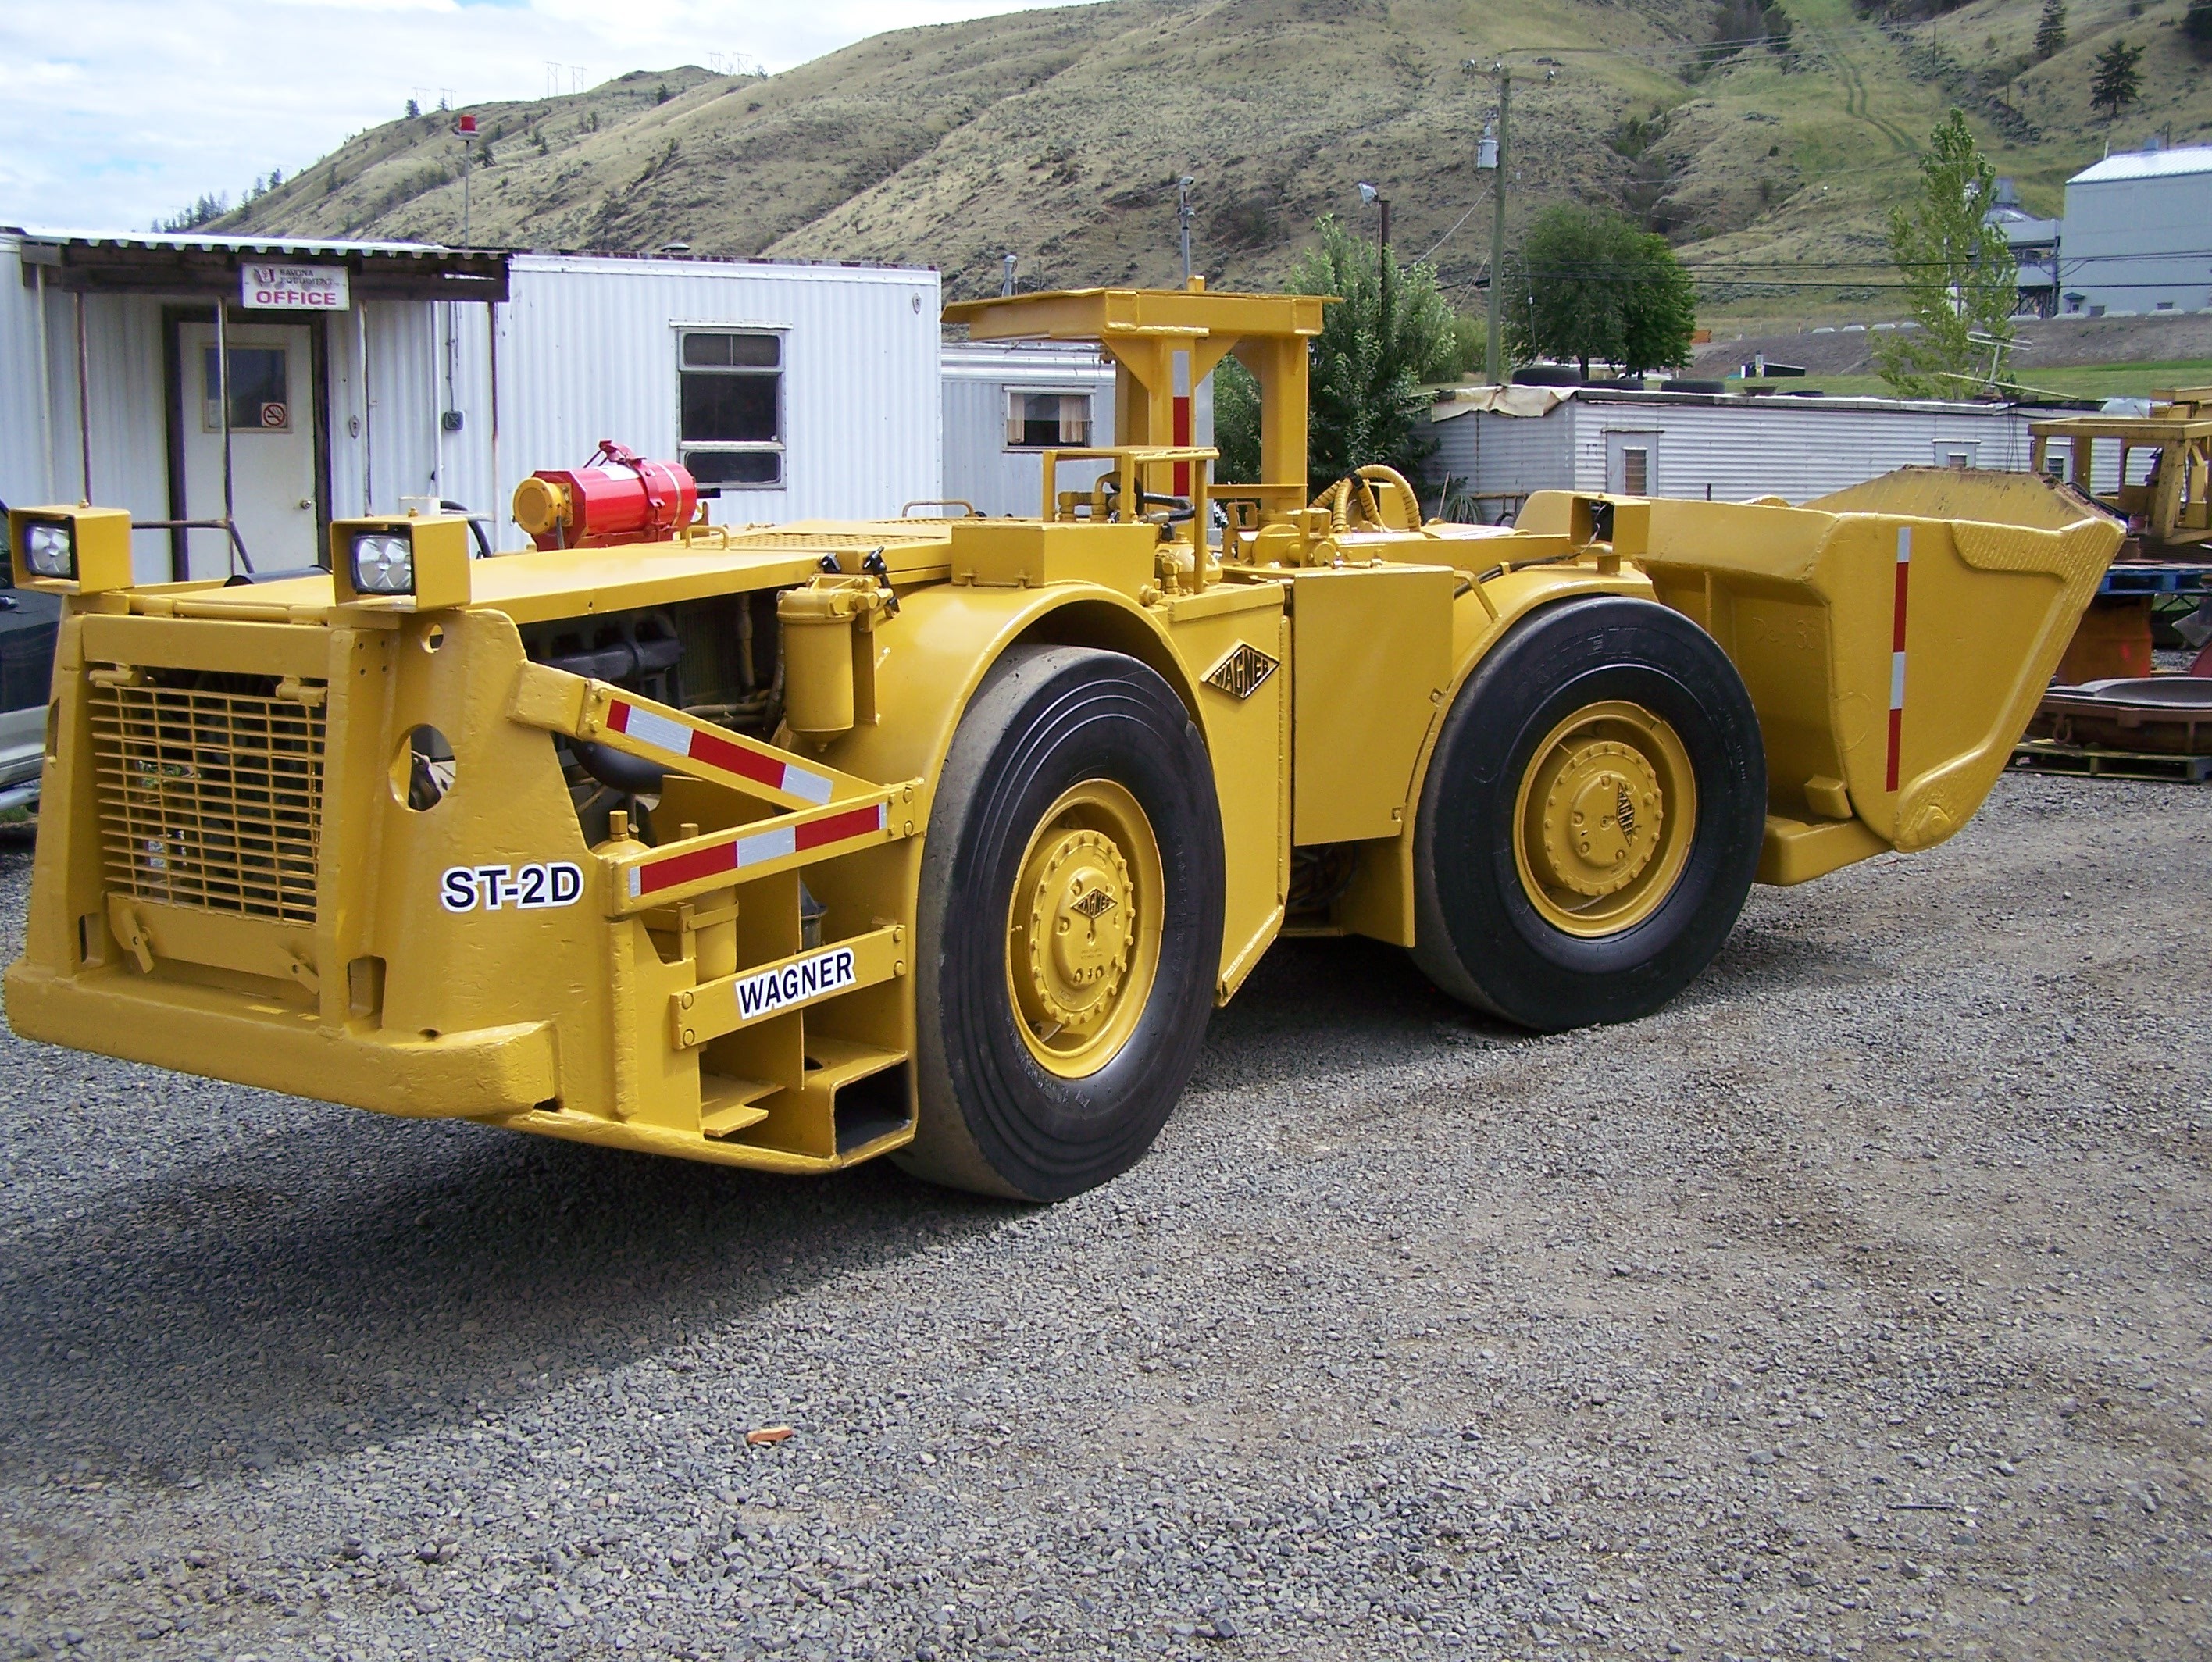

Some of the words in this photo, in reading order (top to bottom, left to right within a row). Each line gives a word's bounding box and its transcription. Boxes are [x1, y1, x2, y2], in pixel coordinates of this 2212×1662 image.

[280, 268, 314, 276] SAVONA
[280, 277, 333, 286] EQUIPMENT
[256, 290, 337, 305] OFFICE
[1215, 647, 1269, 696] WAGNER
[1617, 789, 1634, 836] WAGNER
[444, 865, 580, 908] ST-2D
[1076, 890, 1112, 917] WAGNER
[739, 951, 853, 1015] WAGNER
